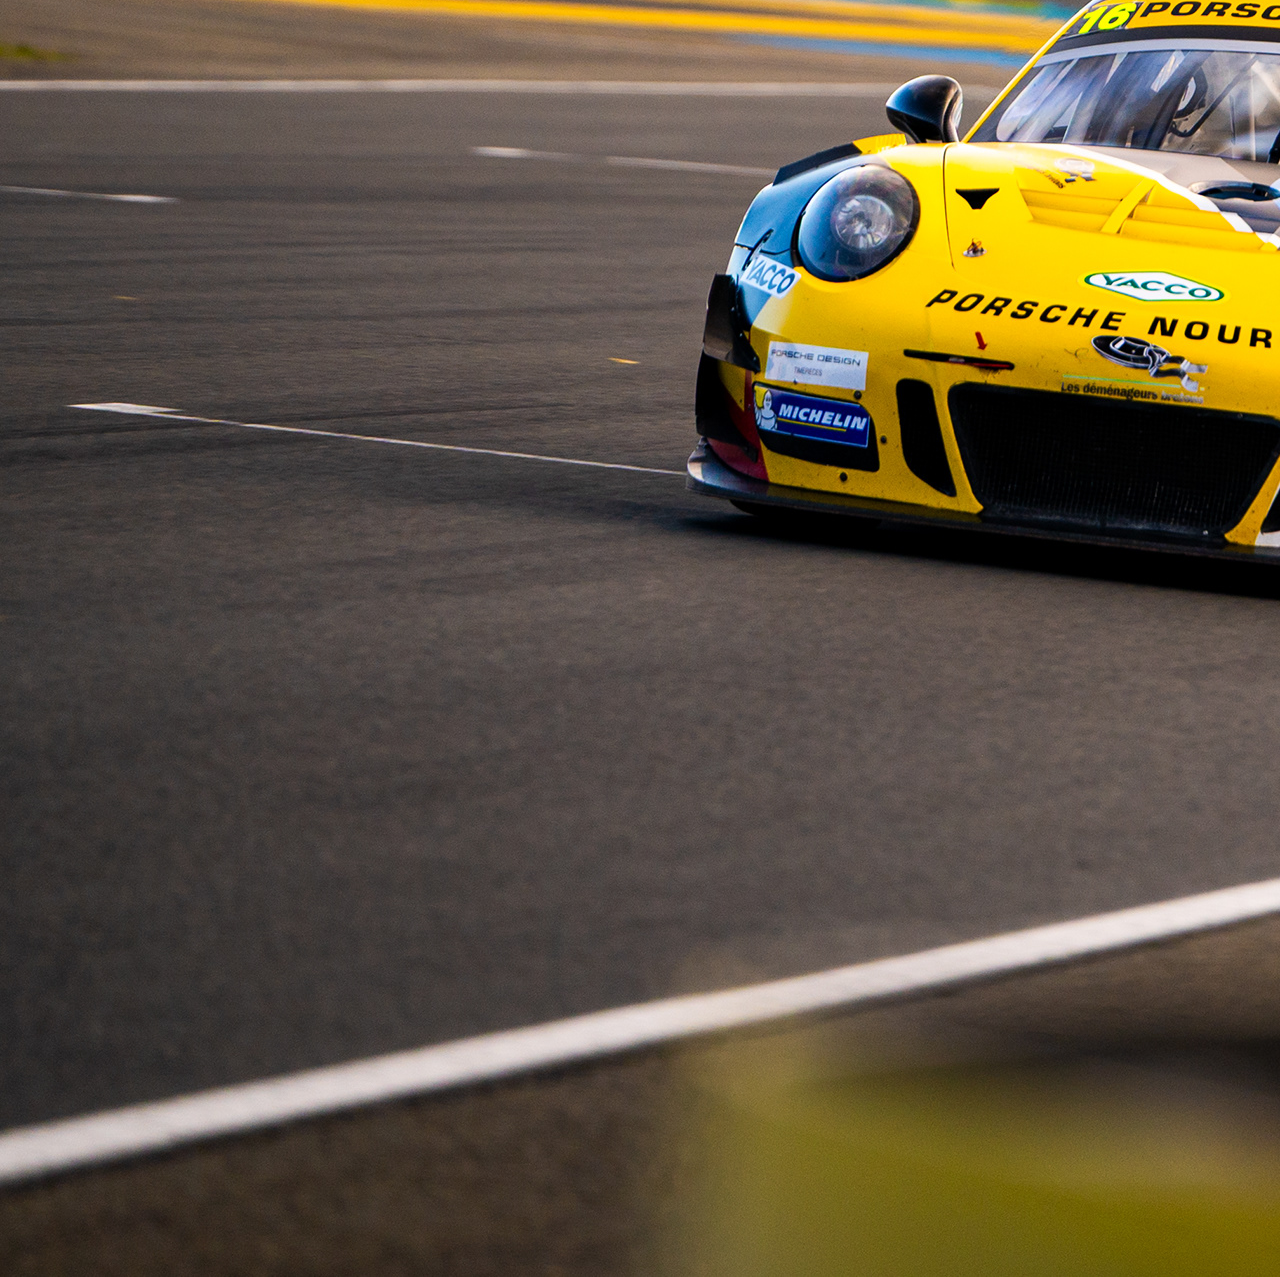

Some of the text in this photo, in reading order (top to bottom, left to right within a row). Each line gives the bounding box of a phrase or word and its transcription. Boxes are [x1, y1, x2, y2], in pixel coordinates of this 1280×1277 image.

[1078, 2, 1138, 34] 16
[746, 258, 796, 294] YACCO
[1101, 273, 1213, 299] YACCO
[925, 289, 1127, 331] PORSCHE
[771, 348, 862, 367] PORSCHE DESIGN
[1061, 382, 1080, 392] Les
[1083, 382, 1158, 400] déménageurs
[778, 403, 868, 430] MICHELIN
